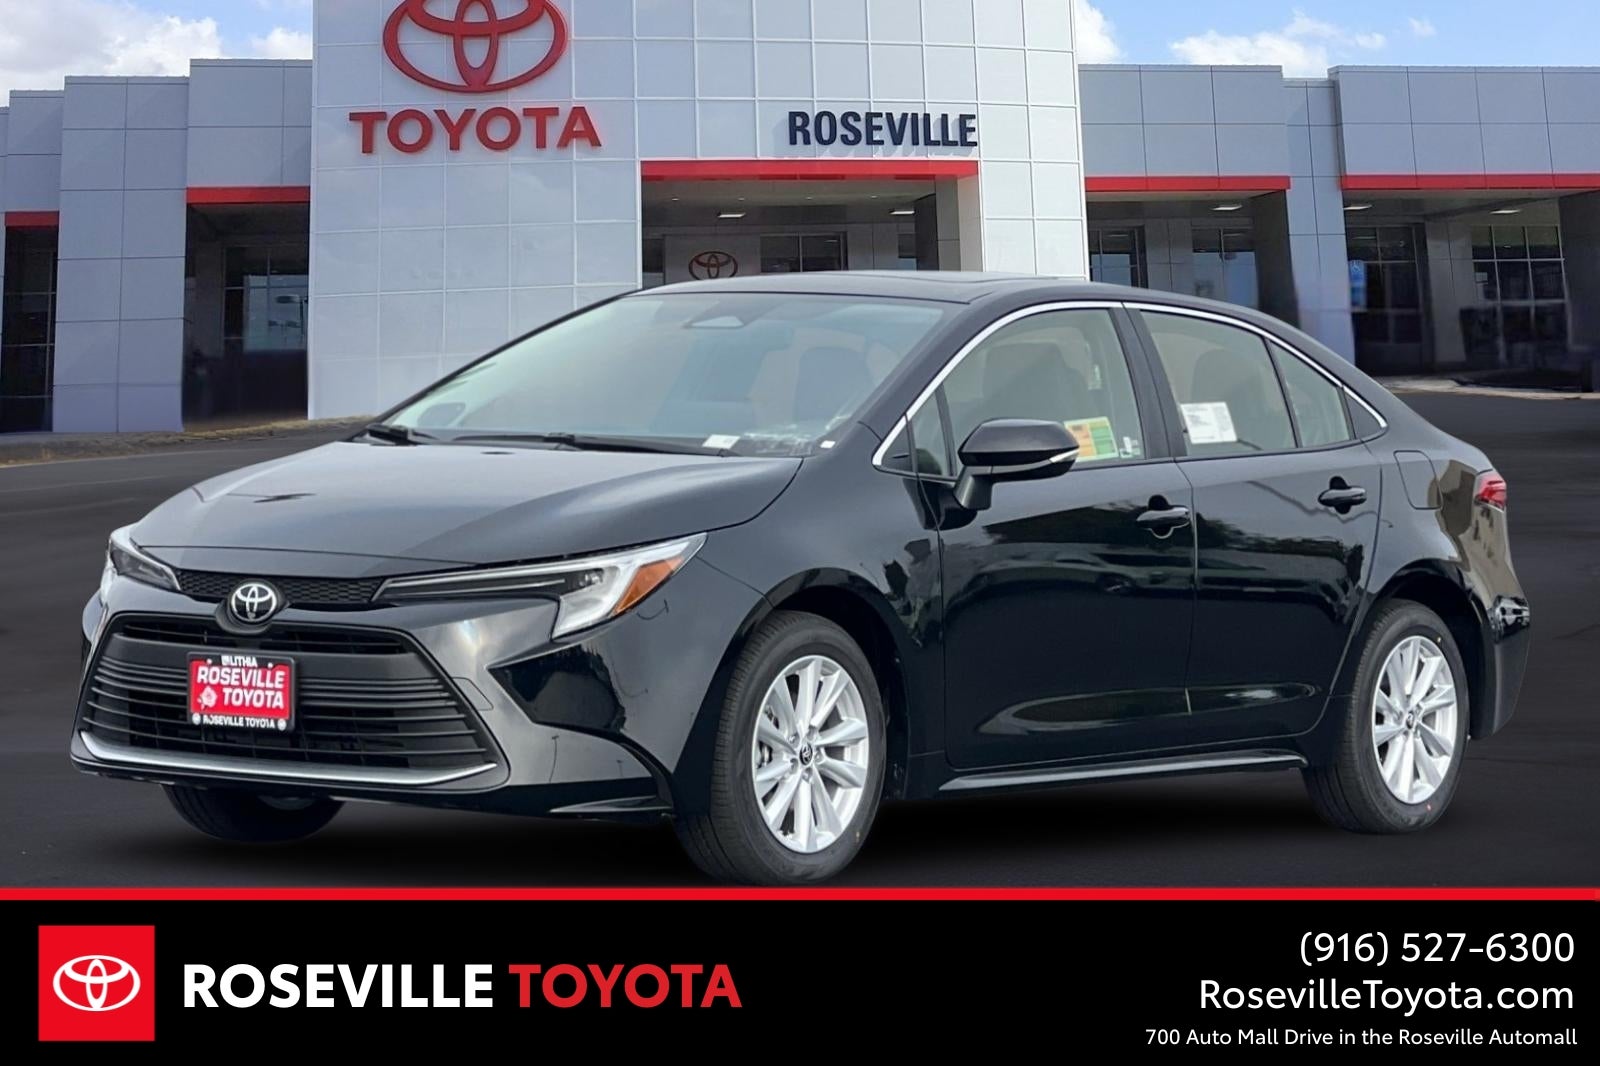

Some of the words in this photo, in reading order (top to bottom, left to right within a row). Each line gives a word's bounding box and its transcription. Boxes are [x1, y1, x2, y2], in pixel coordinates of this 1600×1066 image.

[349, 106, 602, 153] TOYOTA
[788, 111, 978, 147] ROSEVILLE
[197, 666, 285, 689] ROSEVILLE
[222, 687, 284, 710] TOYOTA
[203, 714, 244, 727] ROSEVILLE
[245, 717, 275, 729] TOYOTA
